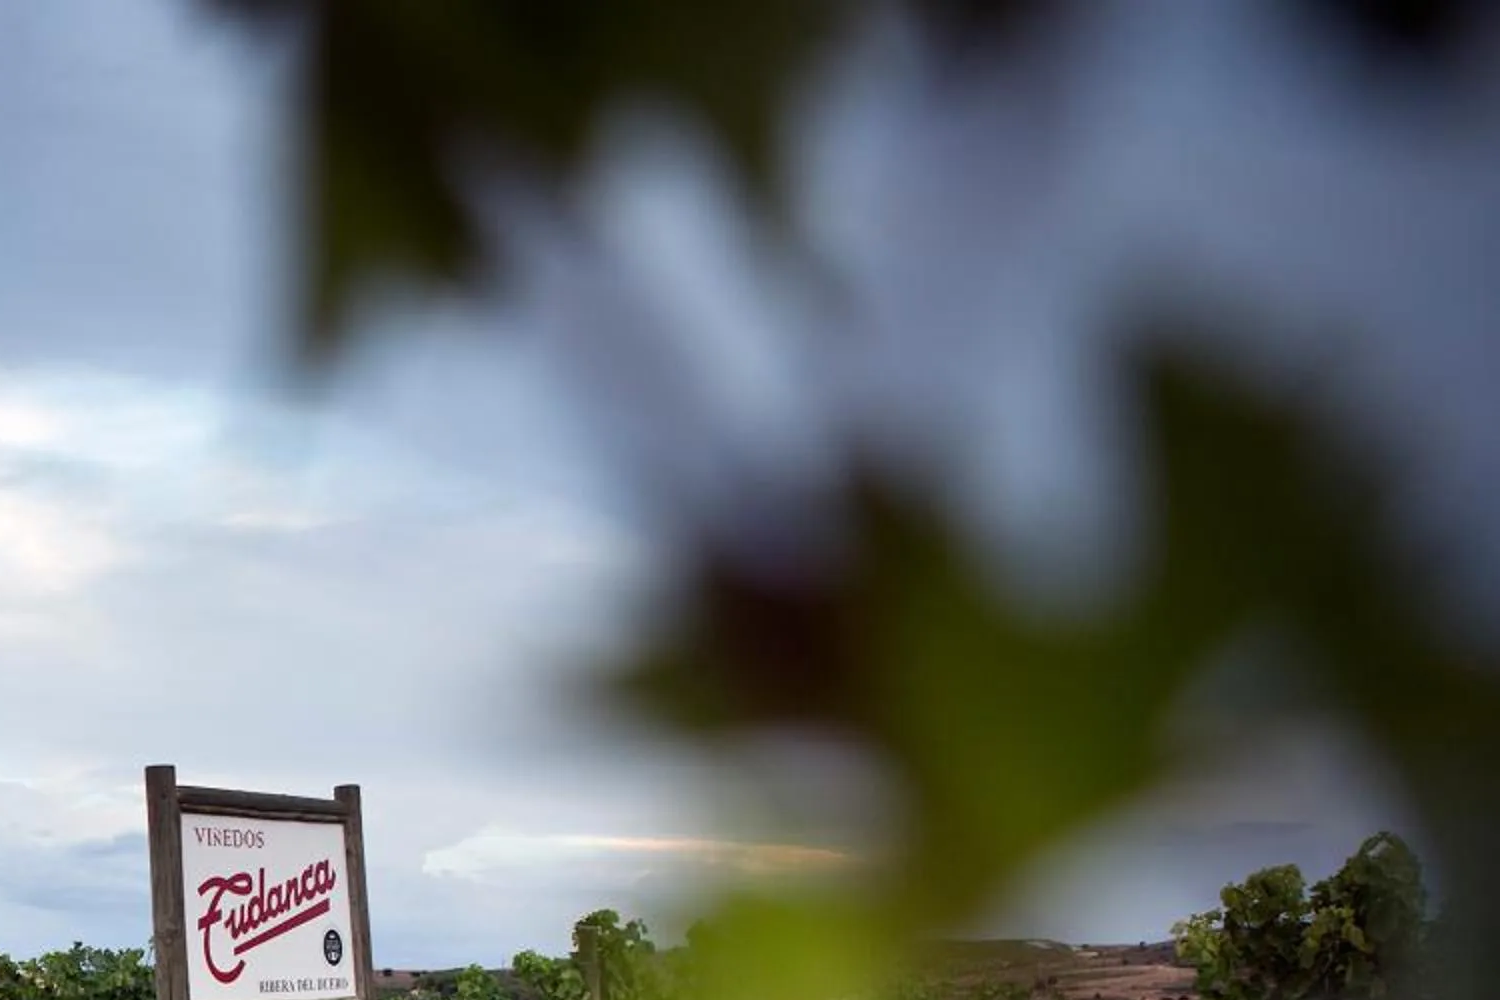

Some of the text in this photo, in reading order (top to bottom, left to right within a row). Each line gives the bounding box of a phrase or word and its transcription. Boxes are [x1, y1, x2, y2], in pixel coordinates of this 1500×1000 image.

[198, 859, 336, 983] Tudanca
[259, 977, 349, 993] RIBERA DEL DUERO
